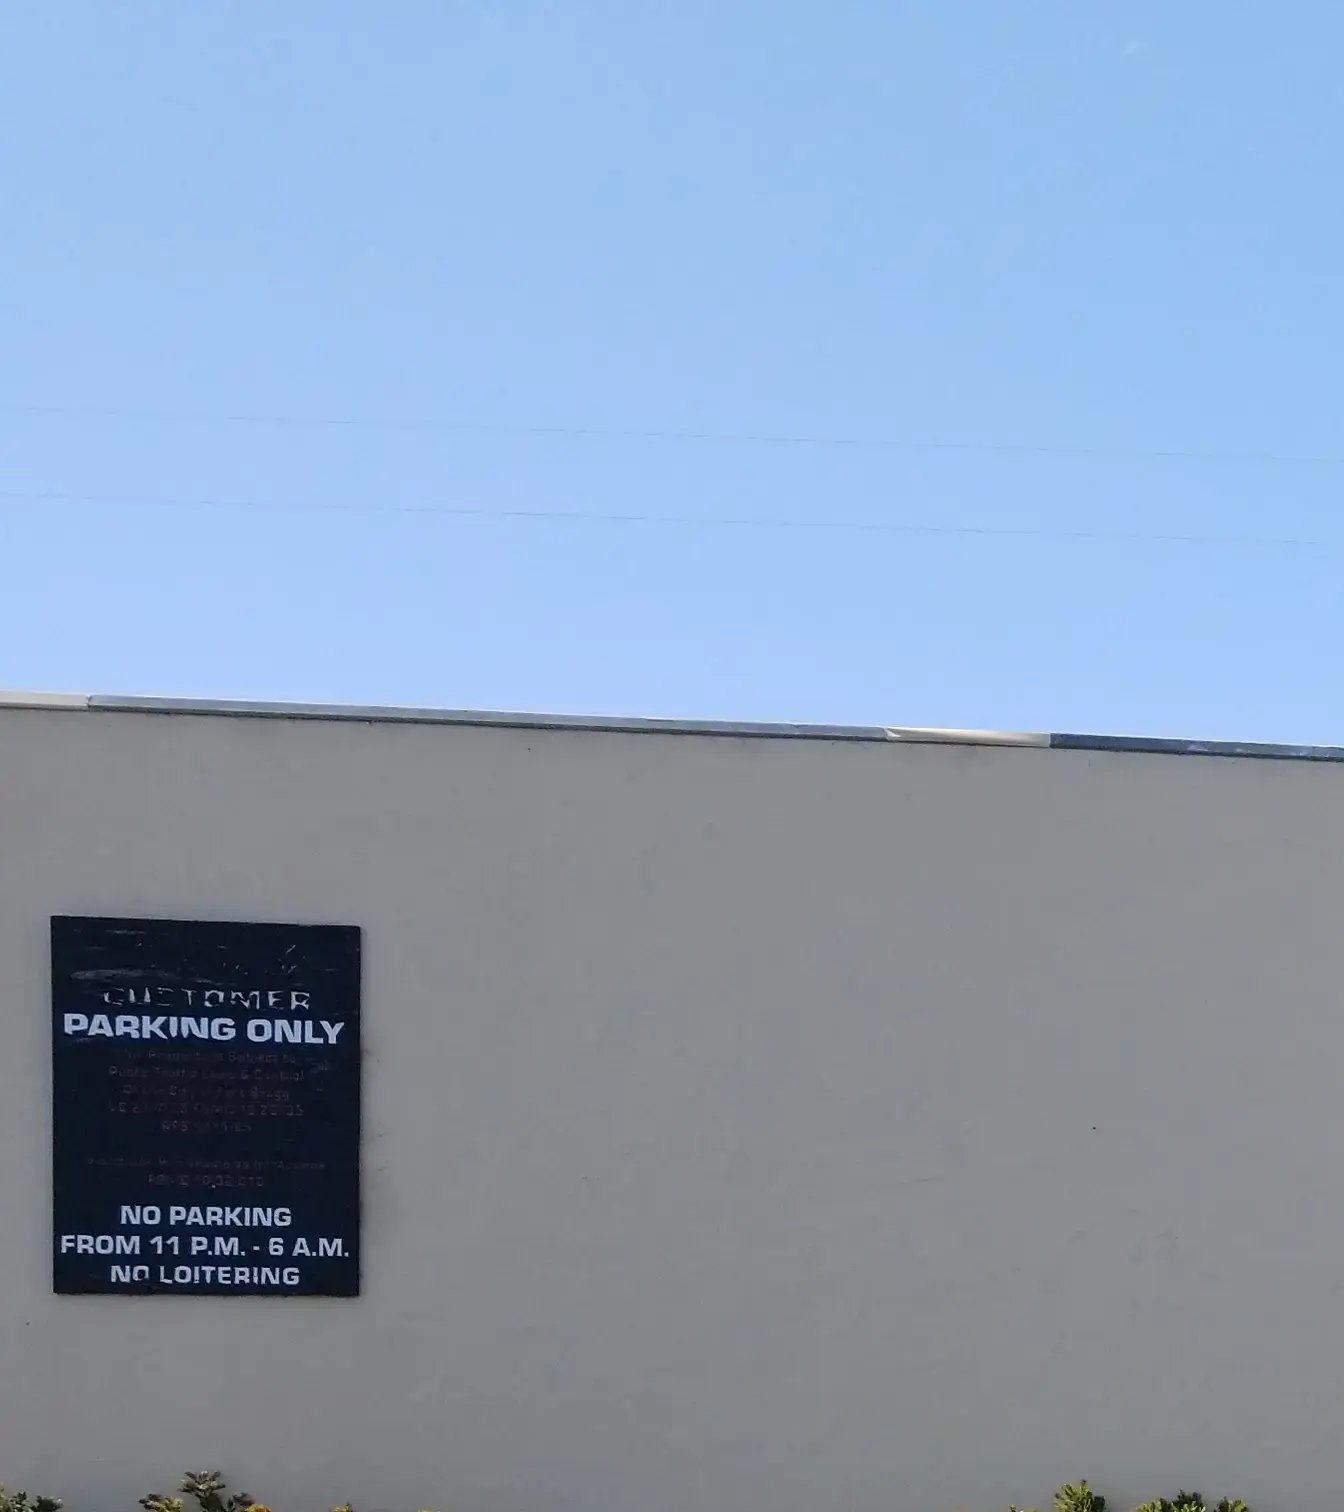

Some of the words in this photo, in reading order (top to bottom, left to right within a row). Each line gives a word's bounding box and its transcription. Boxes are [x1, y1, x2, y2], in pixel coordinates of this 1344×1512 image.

[64, 1013, 236, 1041] PARKING
[246, 1018, 345, 1044] ONLY
[120, 1205, 161, 1225] NO
[169, 1205, 292, 1227] PARKING
[60, 1234, 140, 1255] FROM
[149, 1235, 180, 1256] 11
[190, 1236, 246, 1257] P.M.
[268, 1237, 284, 1257] 6
[292, 1238, 350, 1259] A.M.
[110, 1265, 150, 1284] NO
[159, 1265, 300, 1286] LOITERING
